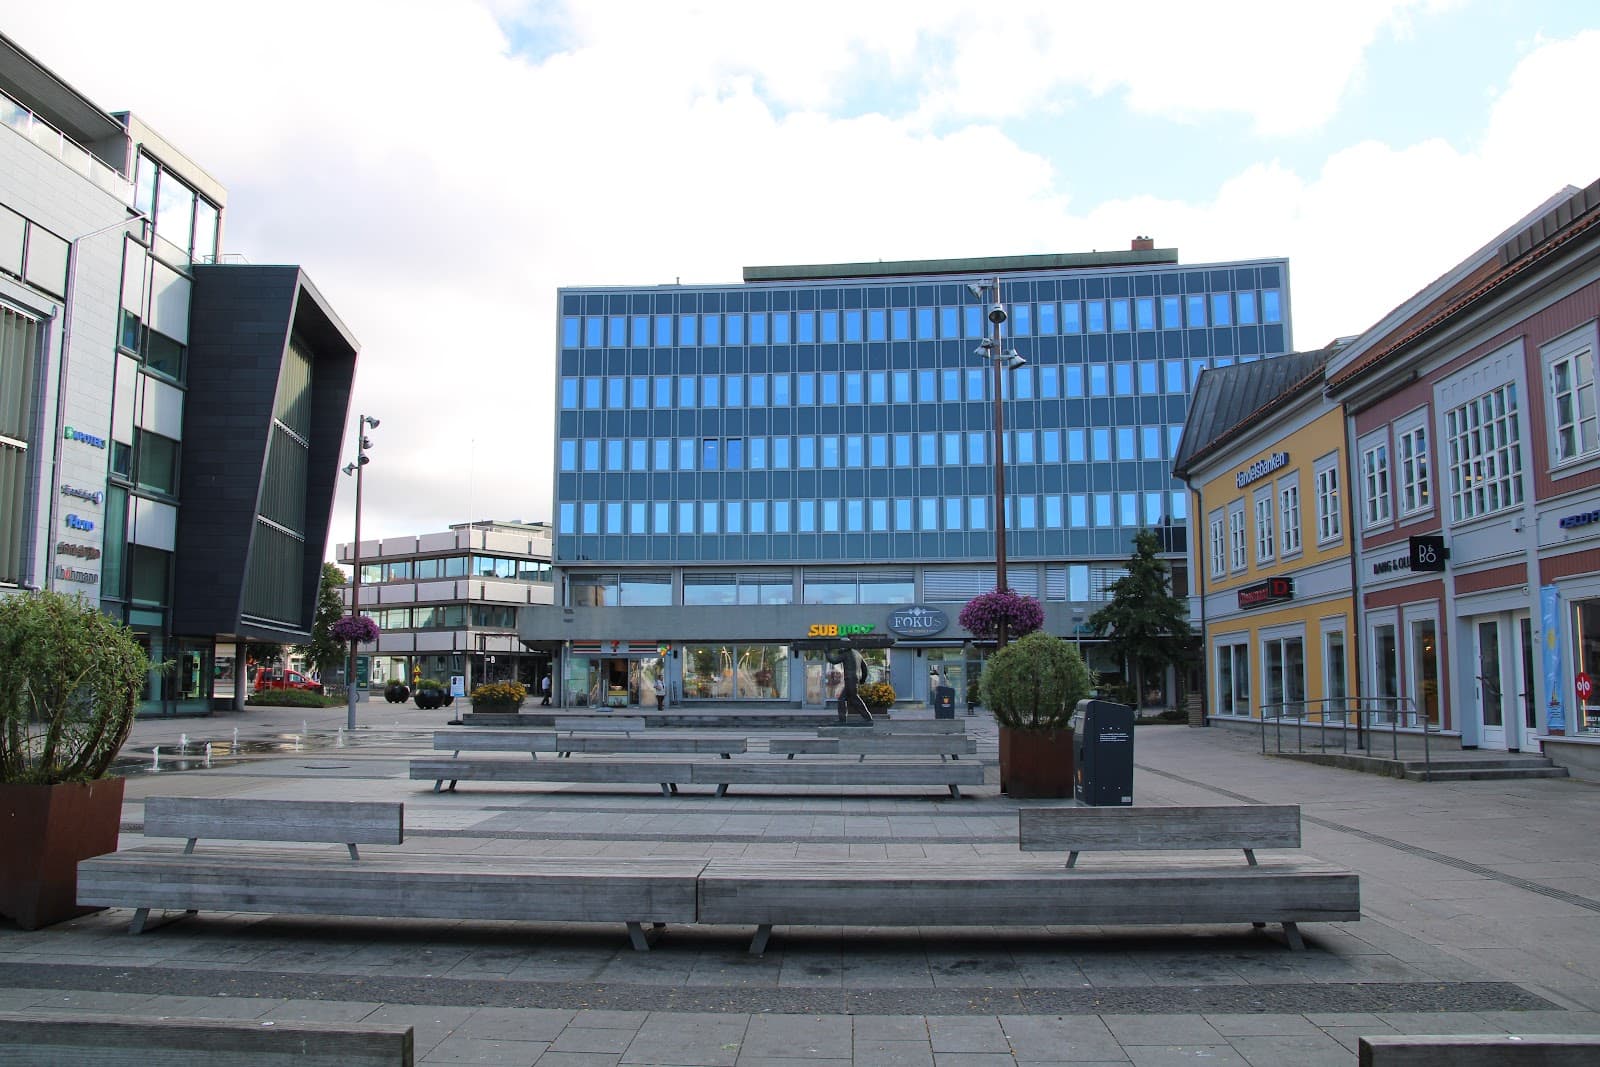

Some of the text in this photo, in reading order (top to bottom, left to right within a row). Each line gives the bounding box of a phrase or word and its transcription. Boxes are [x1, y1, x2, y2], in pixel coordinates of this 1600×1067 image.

[1235, 452, 1287, 488] Handelsbanken
[1273, 580, 1288, 595] D
[894, 616, 941, 628] FOKUS
